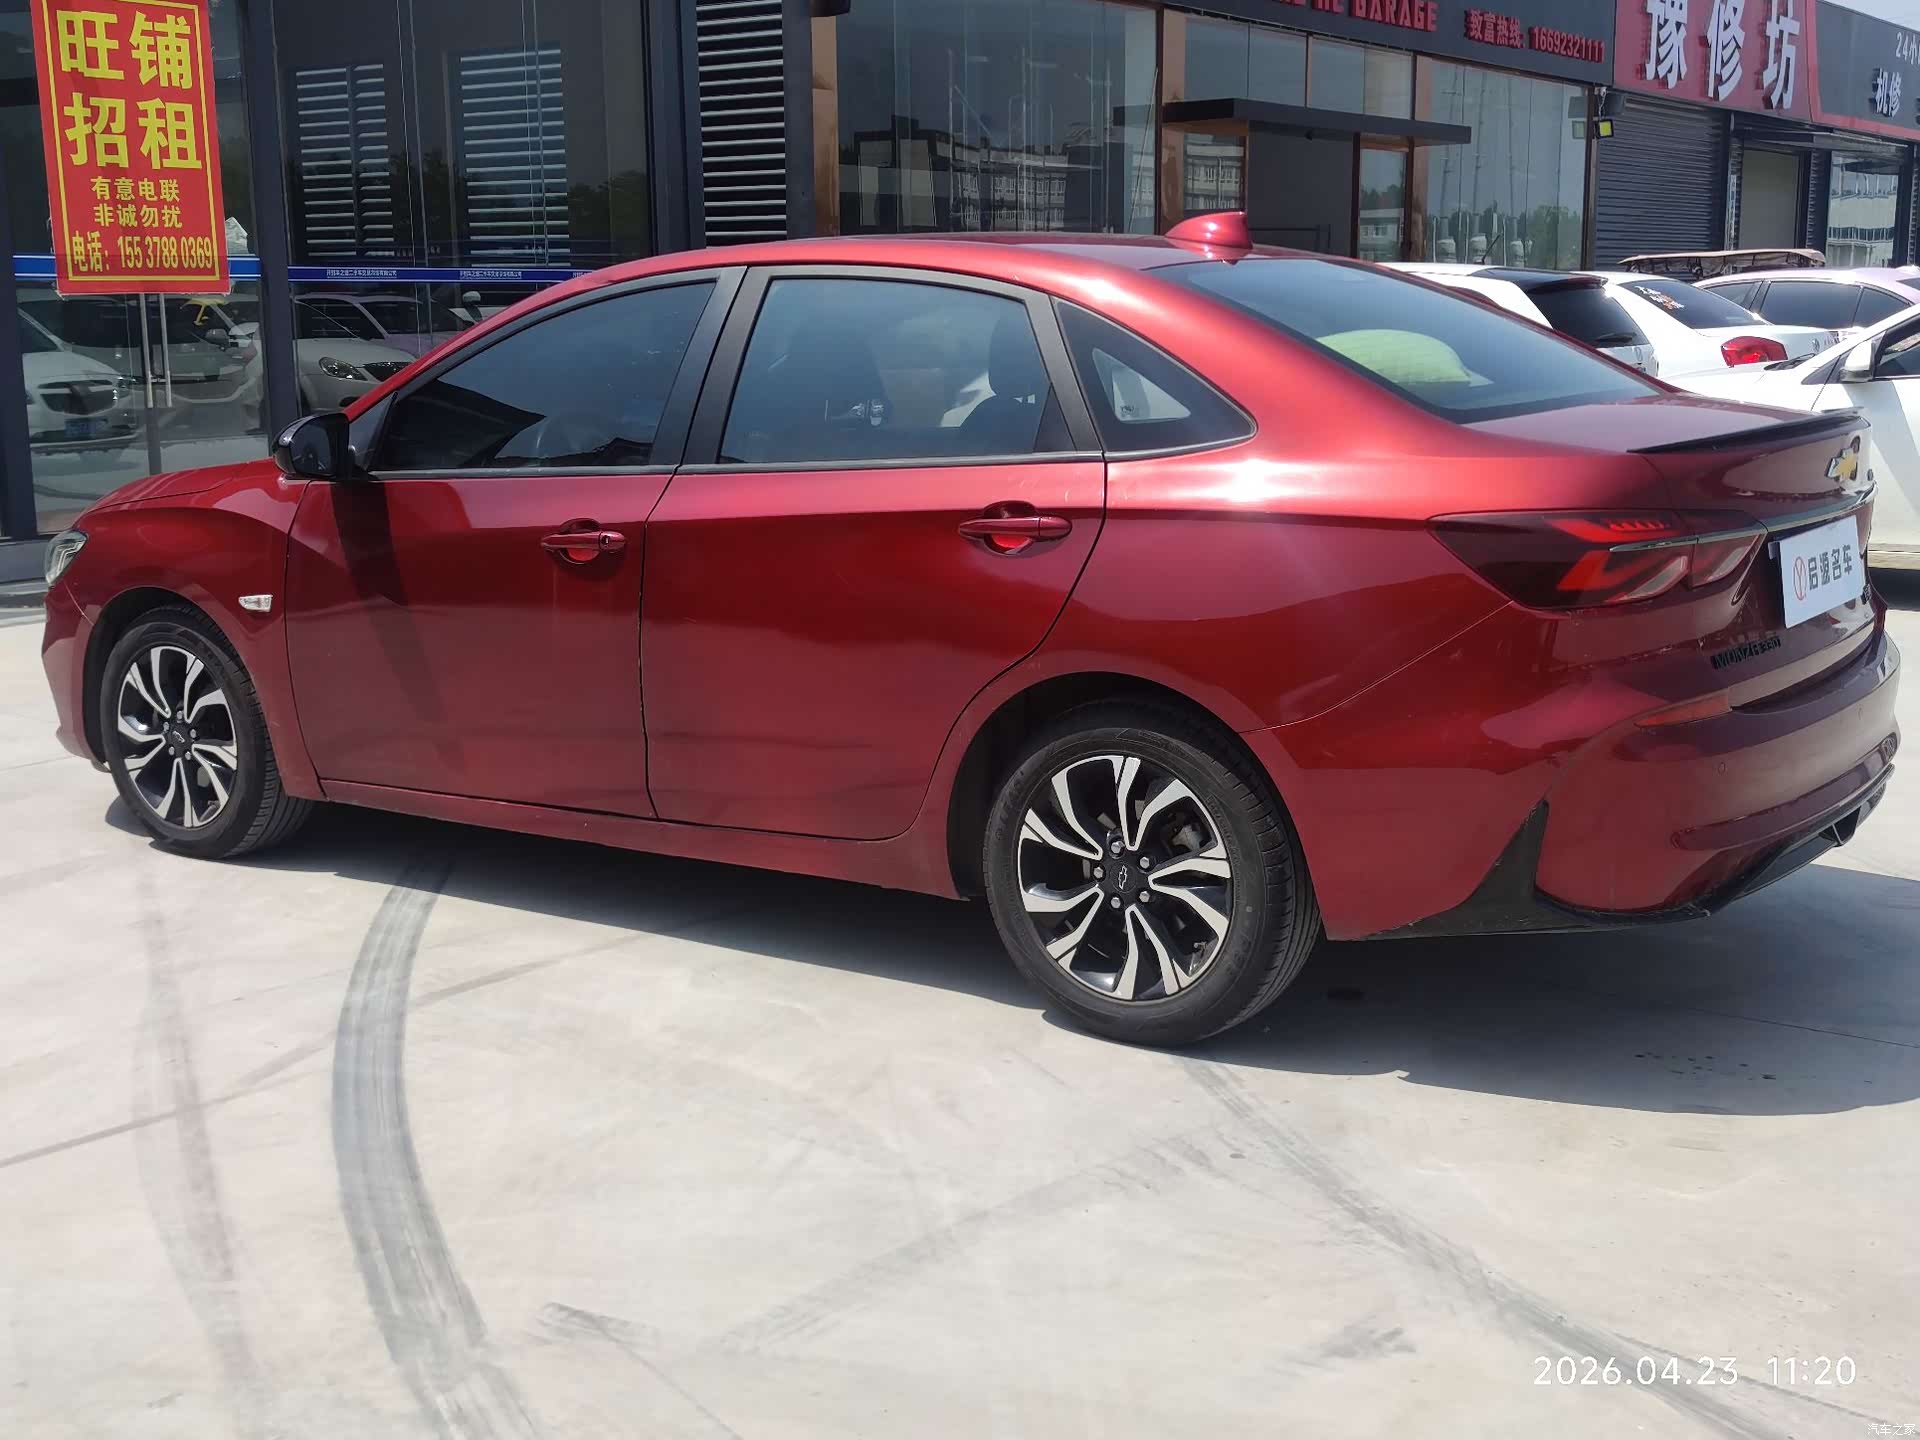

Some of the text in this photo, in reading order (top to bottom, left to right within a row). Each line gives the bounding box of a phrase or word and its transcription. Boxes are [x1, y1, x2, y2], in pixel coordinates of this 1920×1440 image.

[56, 10, 193, 89] 旺铺
[1533, 26, 1605, 64] 16692321111
[1895, 31, 1920, 66] 24小
[1875, 67, 1902, 118] 机修
[63, 92, 202, 169] 招租
[90, 176, 180, 202] 有意电联
[93, 203, 183, 228] 非诚勿扰
[117, 236, 143, 268] 155
[145, 236, 179, 269] 3788
[180, 236, 213, 269] 0369
